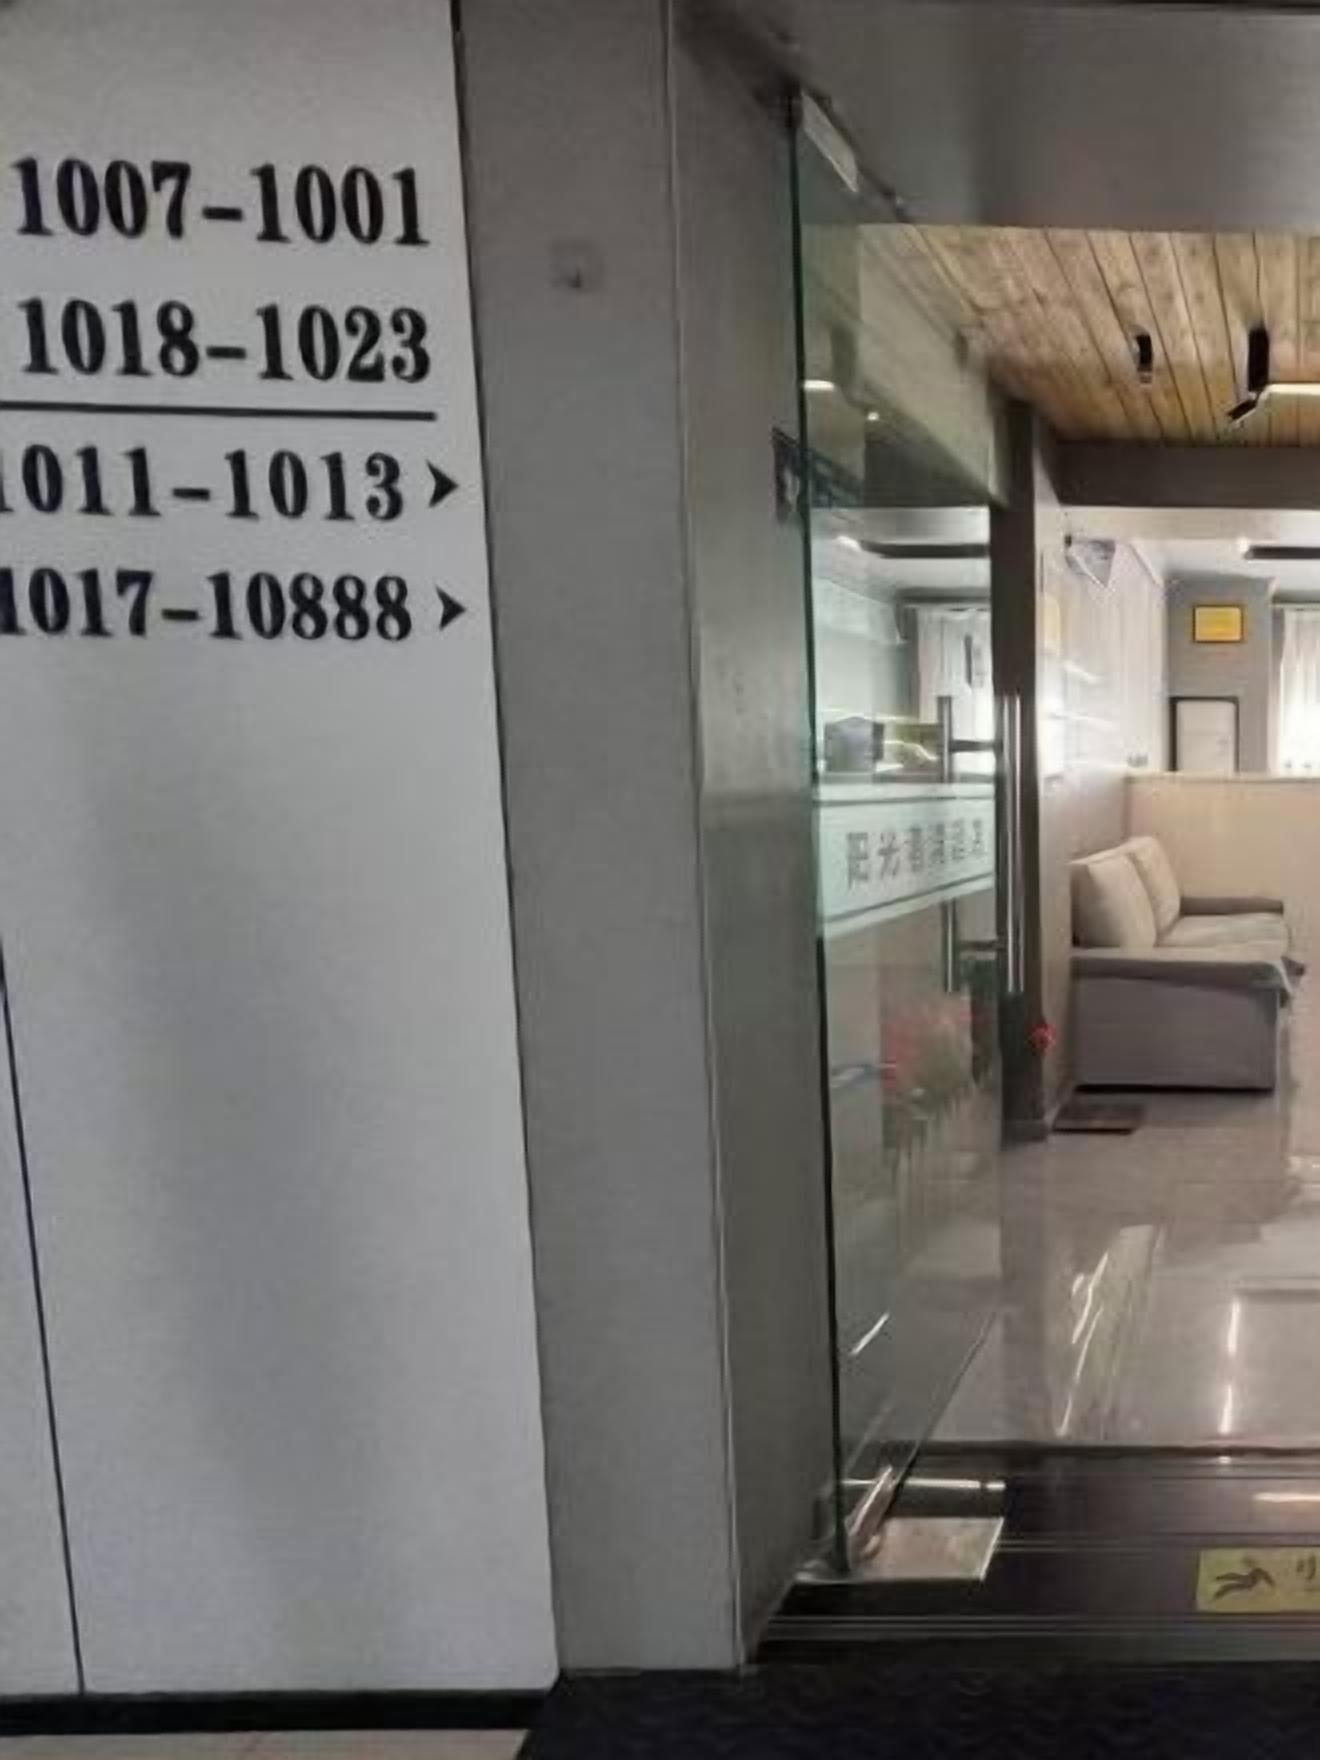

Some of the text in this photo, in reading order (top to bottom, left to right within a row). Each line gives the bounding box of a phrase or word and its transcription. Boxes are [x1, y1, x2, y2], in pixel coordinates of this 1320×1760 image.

[9, 156, 430, 246] 1007-1001
[17, 297, 431, 384] 1018-1023
[0, 565, 413, 642] 1017-10888
